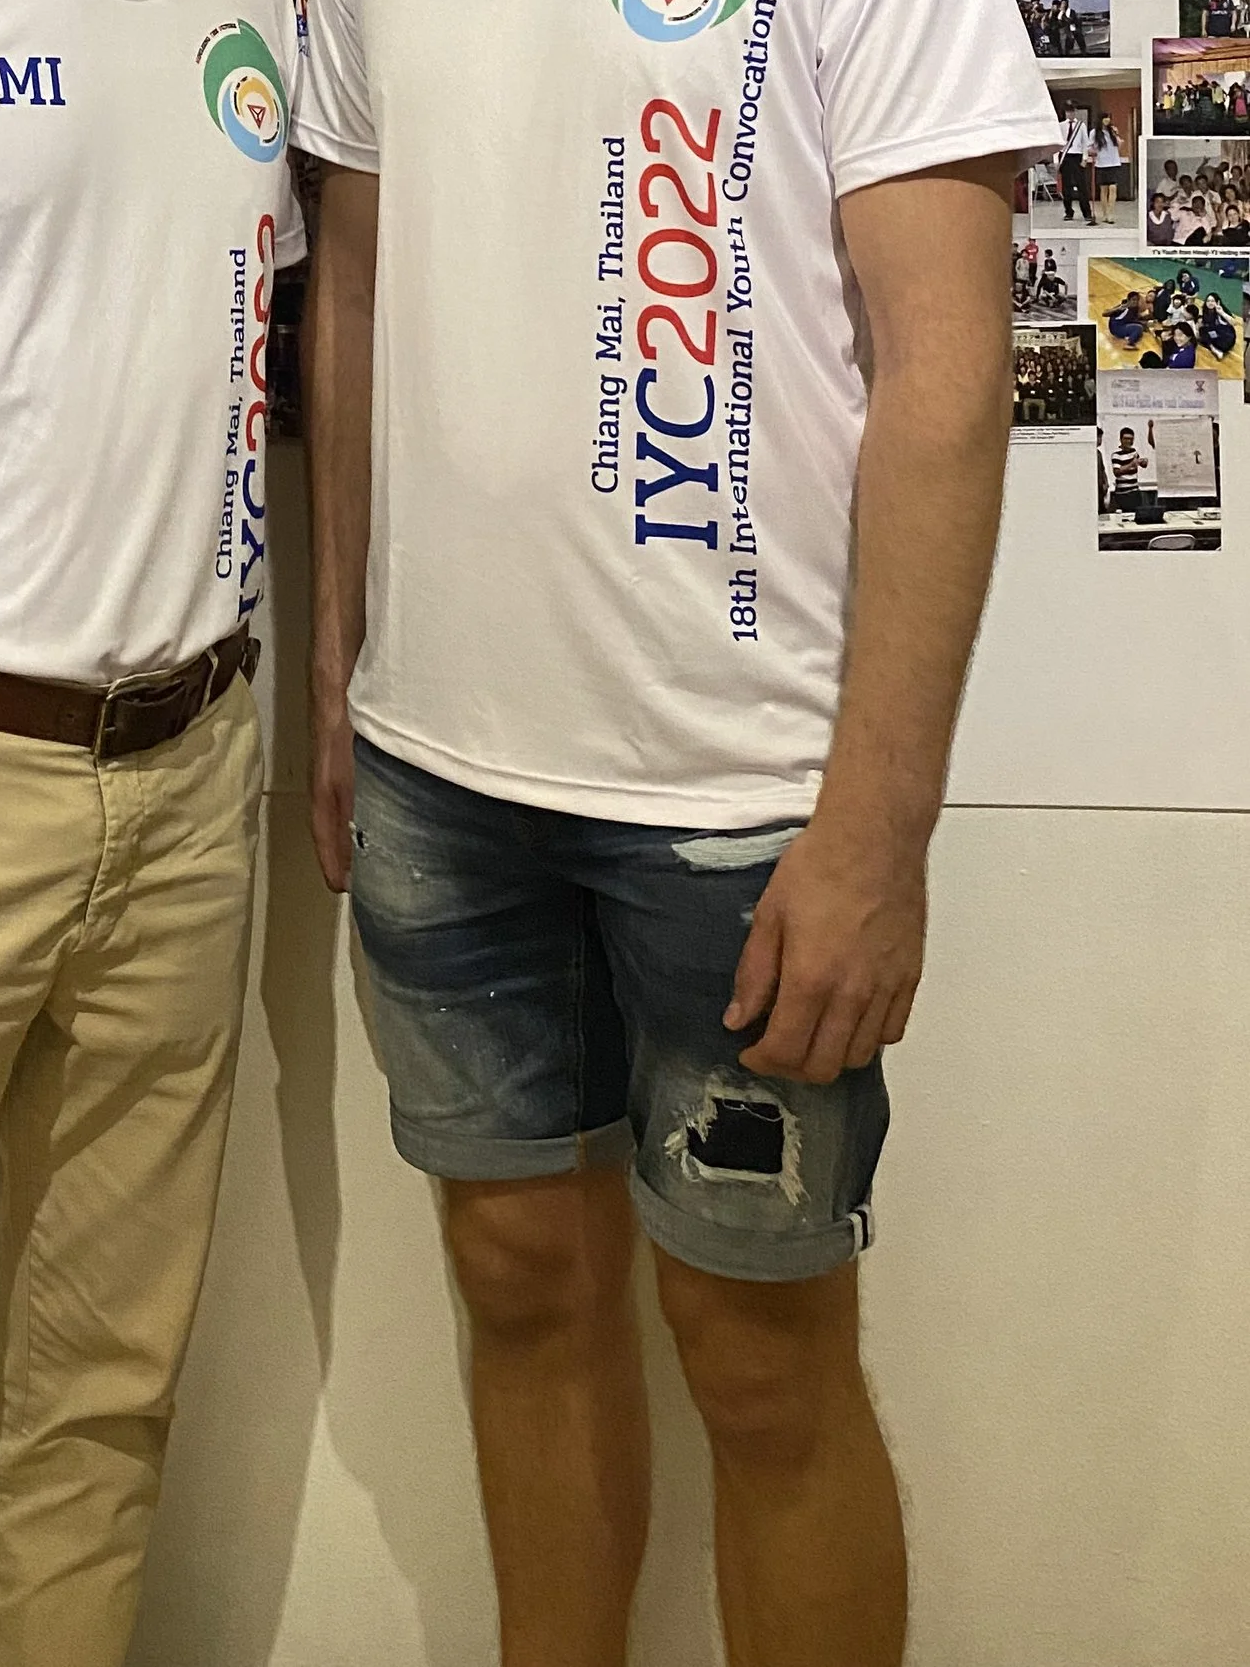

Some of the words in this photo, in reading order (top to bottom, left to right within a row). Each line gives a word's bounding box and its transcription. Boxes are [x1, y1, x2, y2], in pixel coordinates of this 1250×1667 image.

[598, 136, 625, 282] Thailand
[726, 215, 754, 314] Youth
[228, 248, 247, 384] Thailand
[595, 297, 627, 362] Mai,
[635, 98, 722, 551] IYC2022
[225, 395, 244, 457] Mai,
[591, 374, 628, 494] Chiang
[724, 329, 757, 556] International
[215, 469, 240, 580] Chiang
[728, 568, 758, 642] 18th
